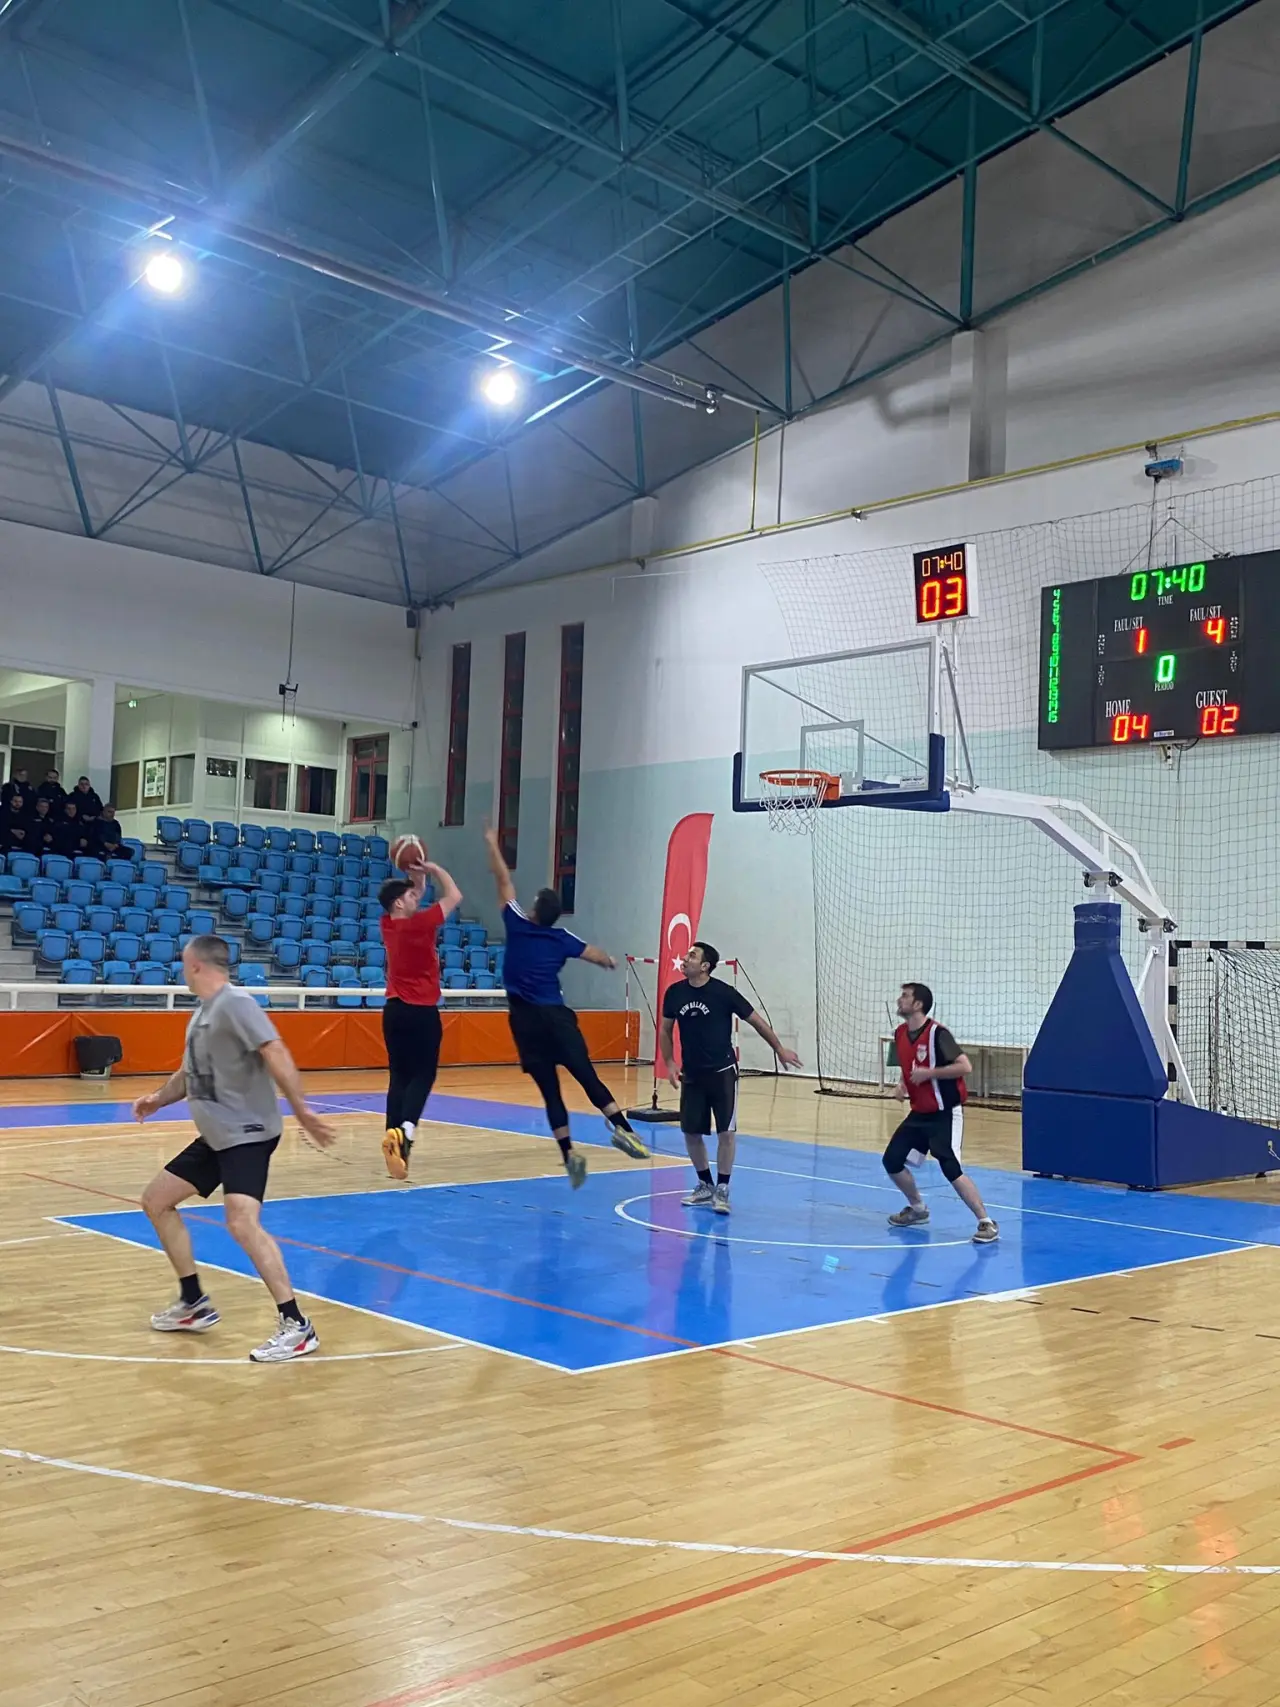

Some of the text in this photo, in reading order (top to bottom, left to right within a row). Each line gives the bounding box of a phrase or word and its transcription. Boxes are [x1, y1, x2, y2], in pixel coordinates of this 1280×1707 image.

[922, 551, 963, 577] 07:40
[1131, 564, 1205, 600] 07:40
[922, 577, 962, 618] 03
[1158, 595, 1174, 606] TIME
[1114, 616, 1143, 632] FAUL/SET
[1189, 605, 1222, 621] FAUL/SET
[1138, 629, 1145, 653] 1
[1207, 619, 1223, 643] 4
[1158, 655, 1175, 683] 0
[1154, 682, 1174, 692] PERIOD
[1195, 689, 1228, 709] GUEST
[1105, 699, 1131, 718] HOME
[1202, 706, 1239, 735] 02
[1113, 714, 1148, 742] 04
